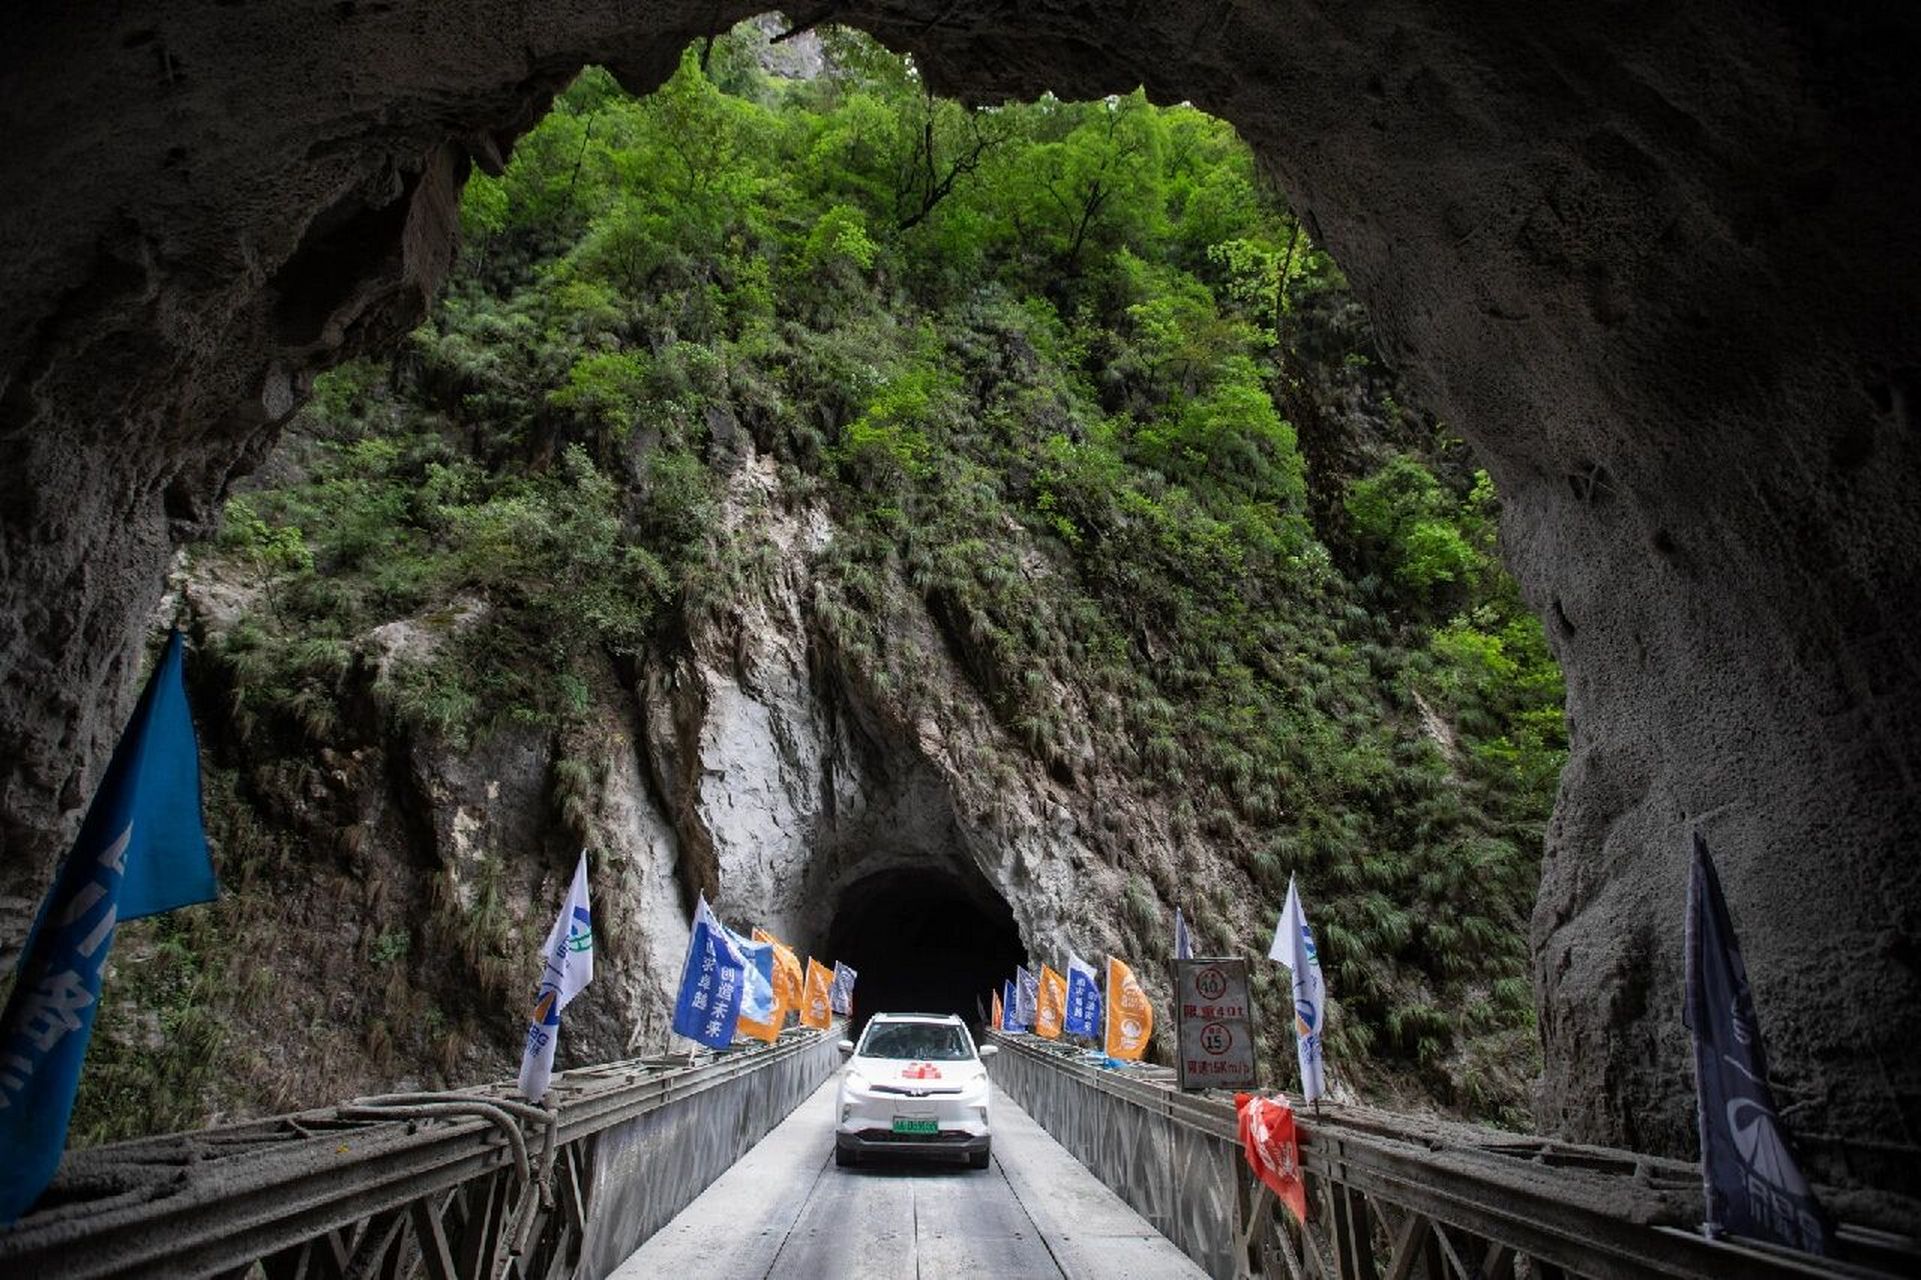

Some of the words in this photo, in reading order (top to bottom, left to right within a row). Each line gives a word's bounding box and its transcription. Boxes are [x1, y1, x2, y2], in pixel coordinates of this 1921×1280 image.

[705, 966, 735, 1038] 创造未来
[1206, 1036, 1223, 1049] 15
